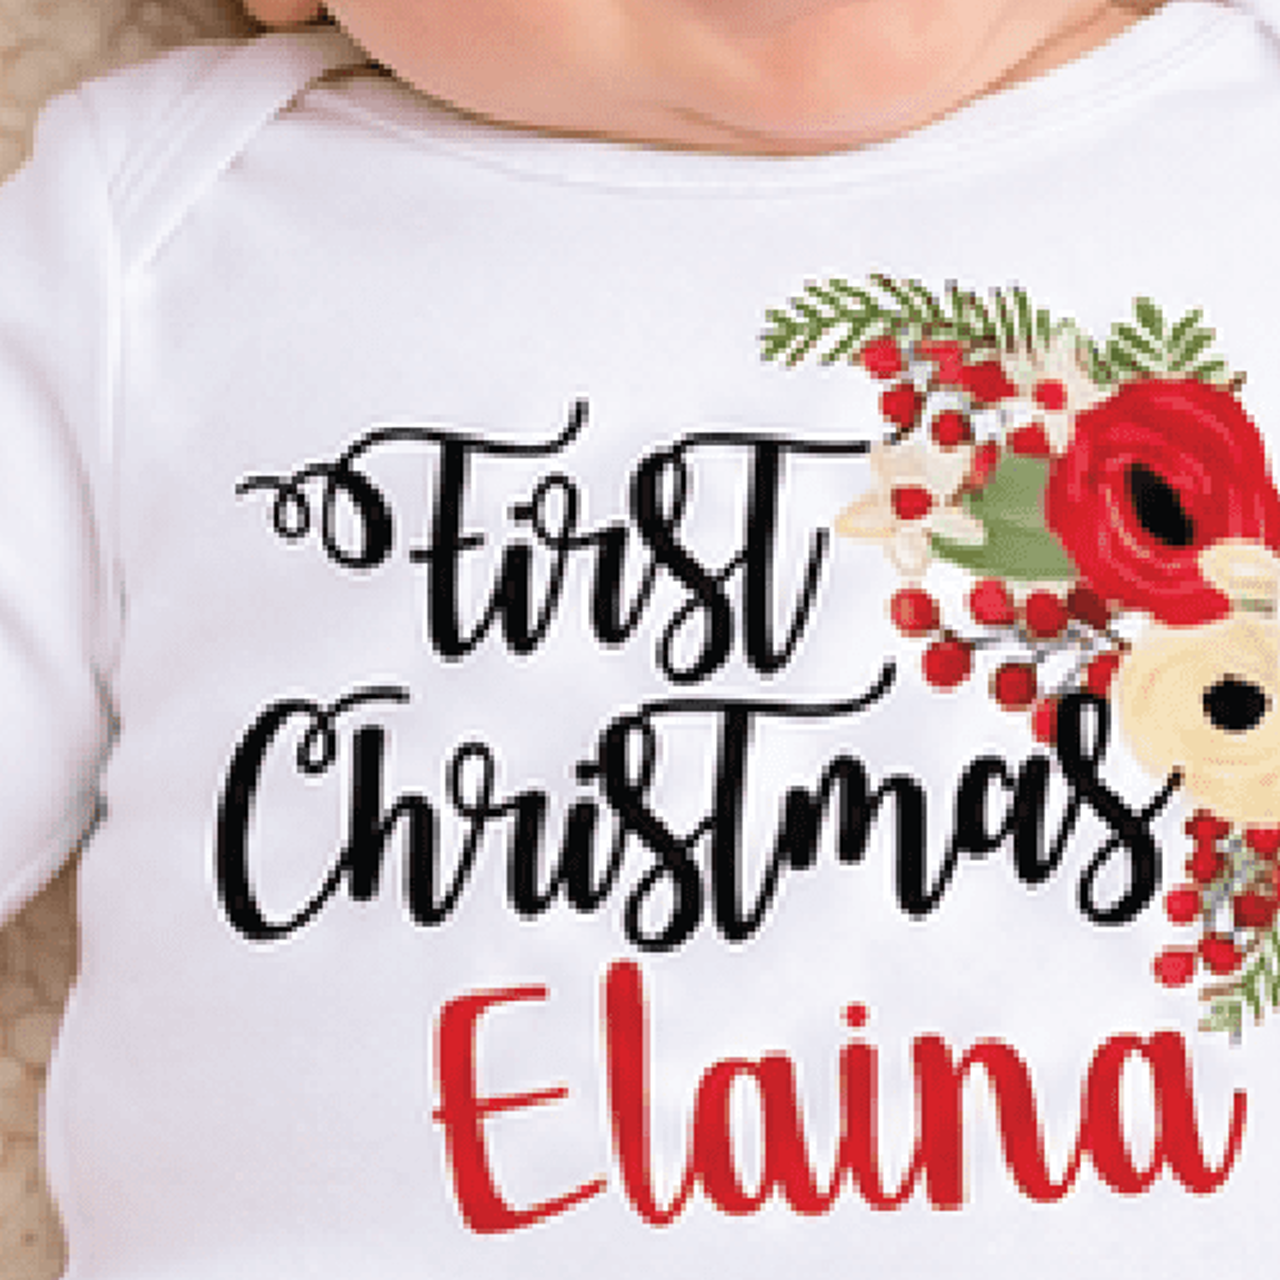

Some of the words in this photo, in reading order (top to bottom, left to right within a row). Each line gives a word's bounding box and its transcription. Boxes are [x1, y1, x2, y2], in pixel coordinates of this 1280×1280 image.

[234, 399, 878, 686] First
[216, 661, 1184, 953] Christmas
[431, 960, 1249, 1234] Elaina
